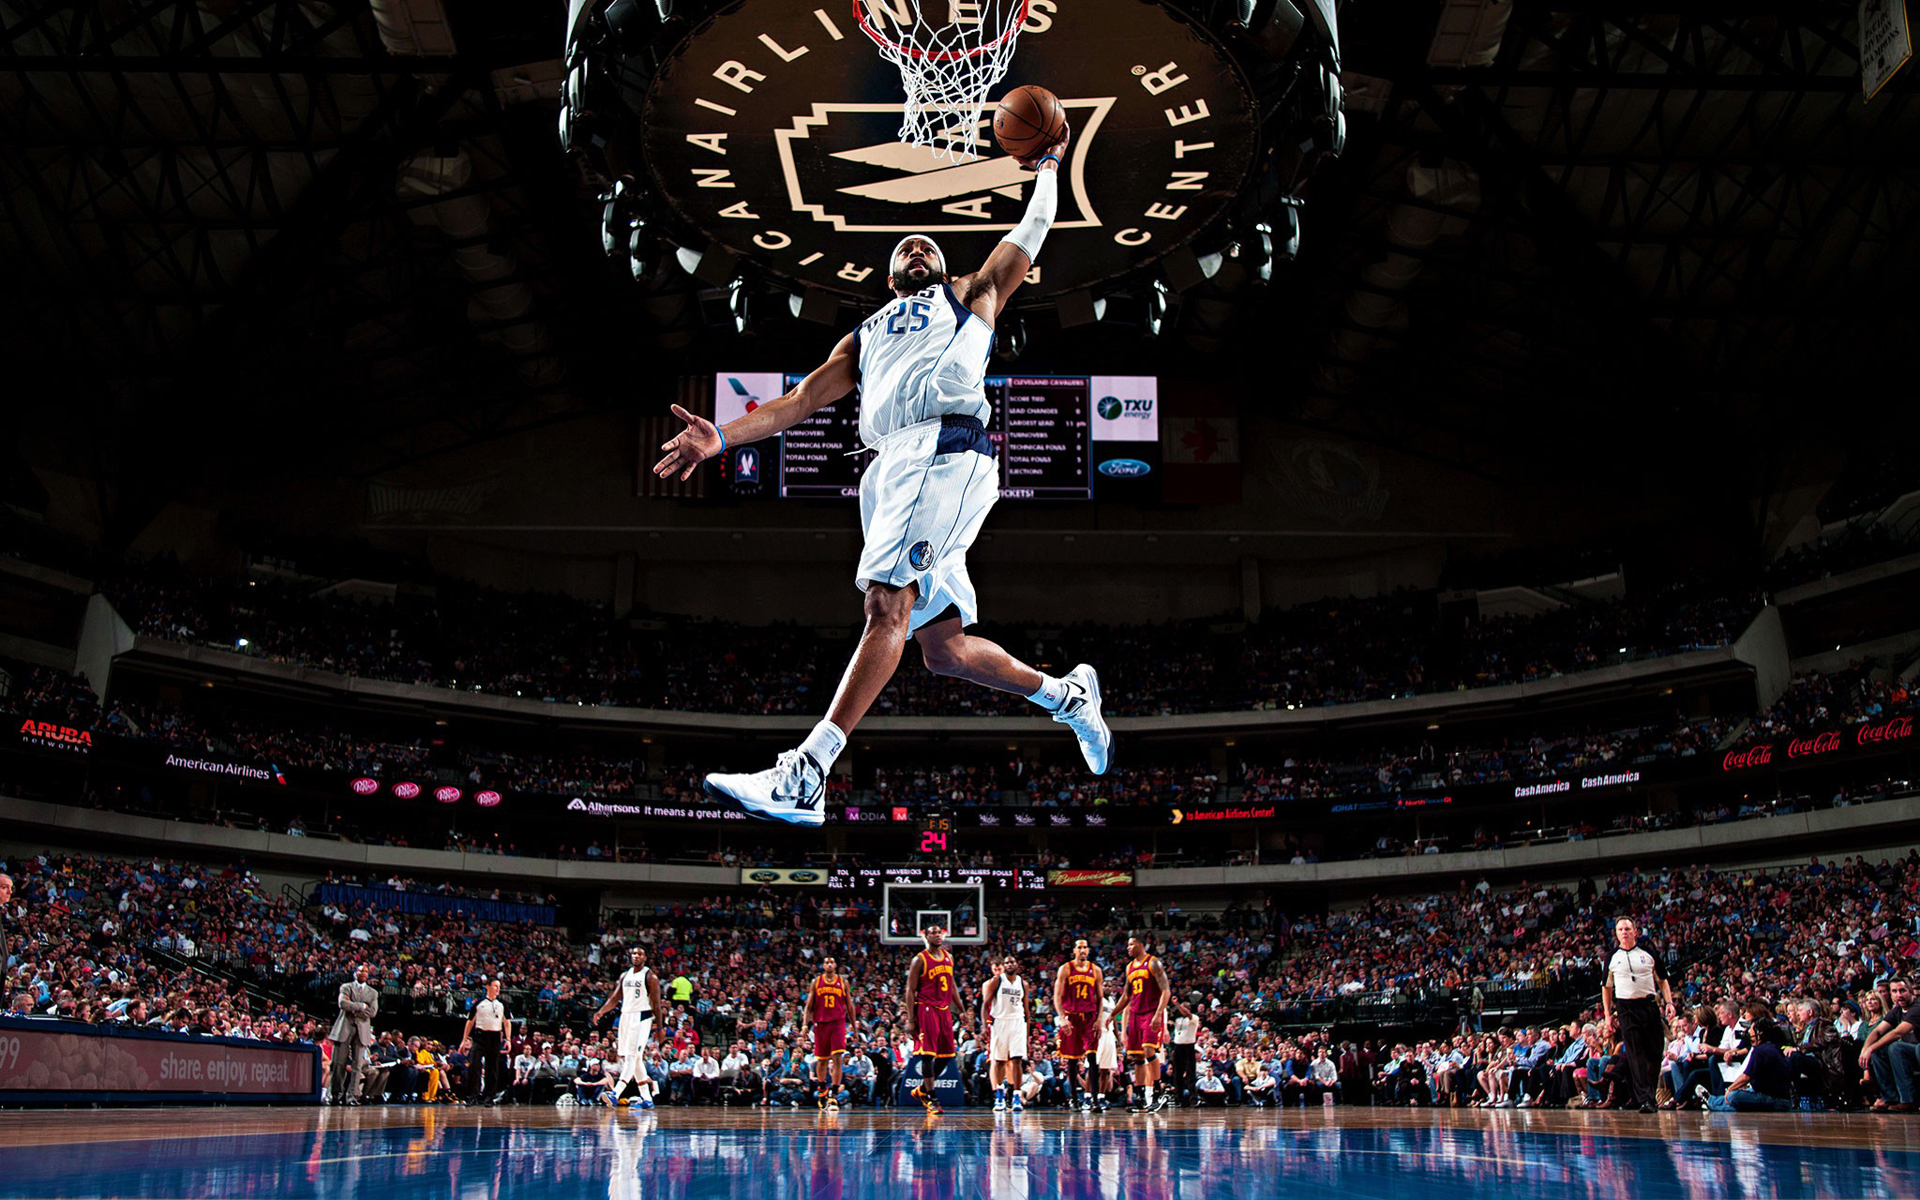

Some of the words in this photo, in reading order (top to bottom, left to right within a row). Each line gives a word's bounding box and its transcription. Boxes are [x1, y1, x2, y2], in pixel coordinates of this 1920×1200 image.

[887, 301, 931, 335] 25
[1124, 400, 1153, 411] TXU
[1124, 411, 1152, 420] energy
[1108, 461, 1141, 475] Ford
[20, 719, 93, 747] ARUBA
[1857, 716, 1914, 745] Coca-Cola
[22, 736, 88, 754] networks
[1788, 731, 1841, 758] Coca-Cola
[1723, 744, 1773, 771] Coca-Cola
[166, 754, 224, 773] American
[225, 763, 270, 780] Airlines
[587, 801, 640, 813] Albertsons
[645, 805, 652, 815] It
[654, 807, 686, 817] means
[688, 809, 694, 817] a
[696, 808, 721, 820] great
[921, 831, 947, 852] 24
[999, 878, 1007, 887] 2
[1054, 871, 1115, 885] Budweiser
[940, 976, 948, 992] 3
[1076, 984, 1088, 1000] 14
[635, 989, 642, 999] 9
[824, 995, 835, 1008] 13
[160, 1052, 203, 1081] share.
[207, 1055, 247, 1087] enjoy.
[251, 1060, 290, 1088] repeat.
[905, 1078, 958, 1089] SOUWEST
